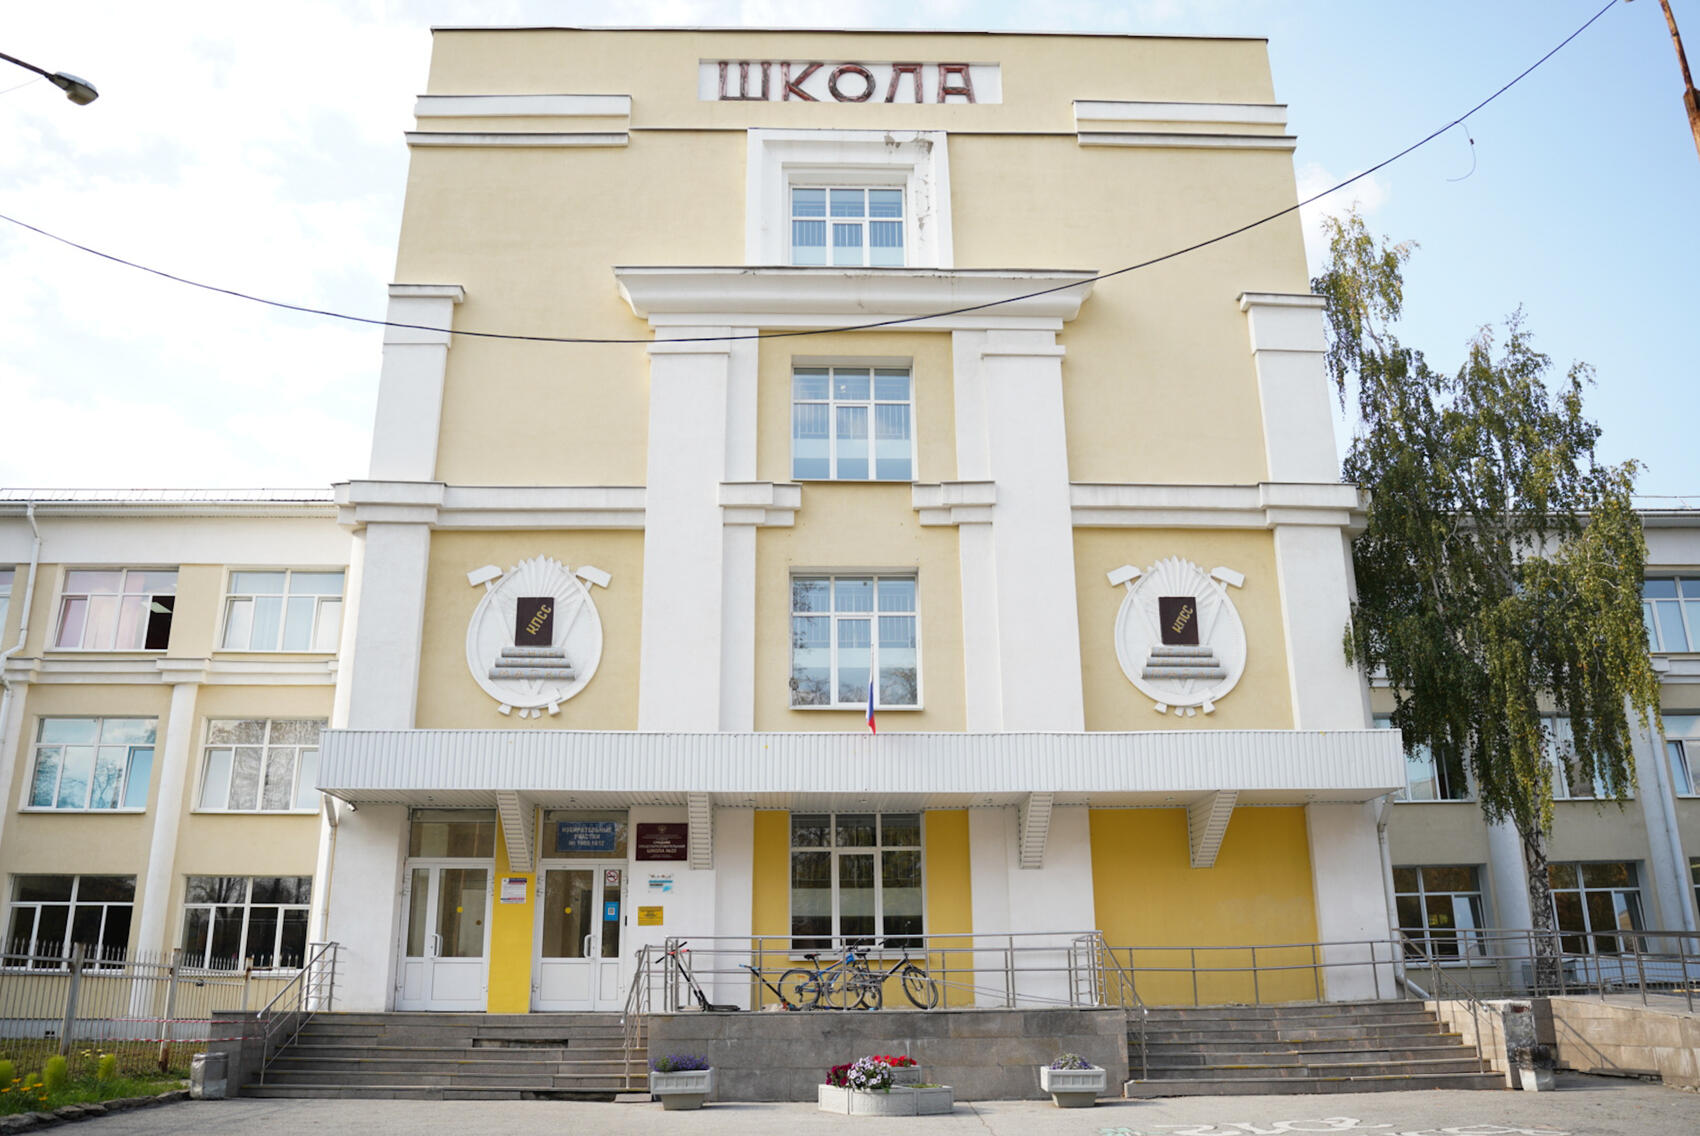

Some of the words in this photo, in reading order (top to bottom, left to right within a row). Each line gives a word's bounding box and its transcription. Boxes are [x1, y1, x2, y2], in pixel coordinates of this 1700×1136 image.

[718, 61, 976, 104] ШКОЛА
[525, 604, 552, 635] КПСС
[1171, 604, 1194, 634] КПСС
